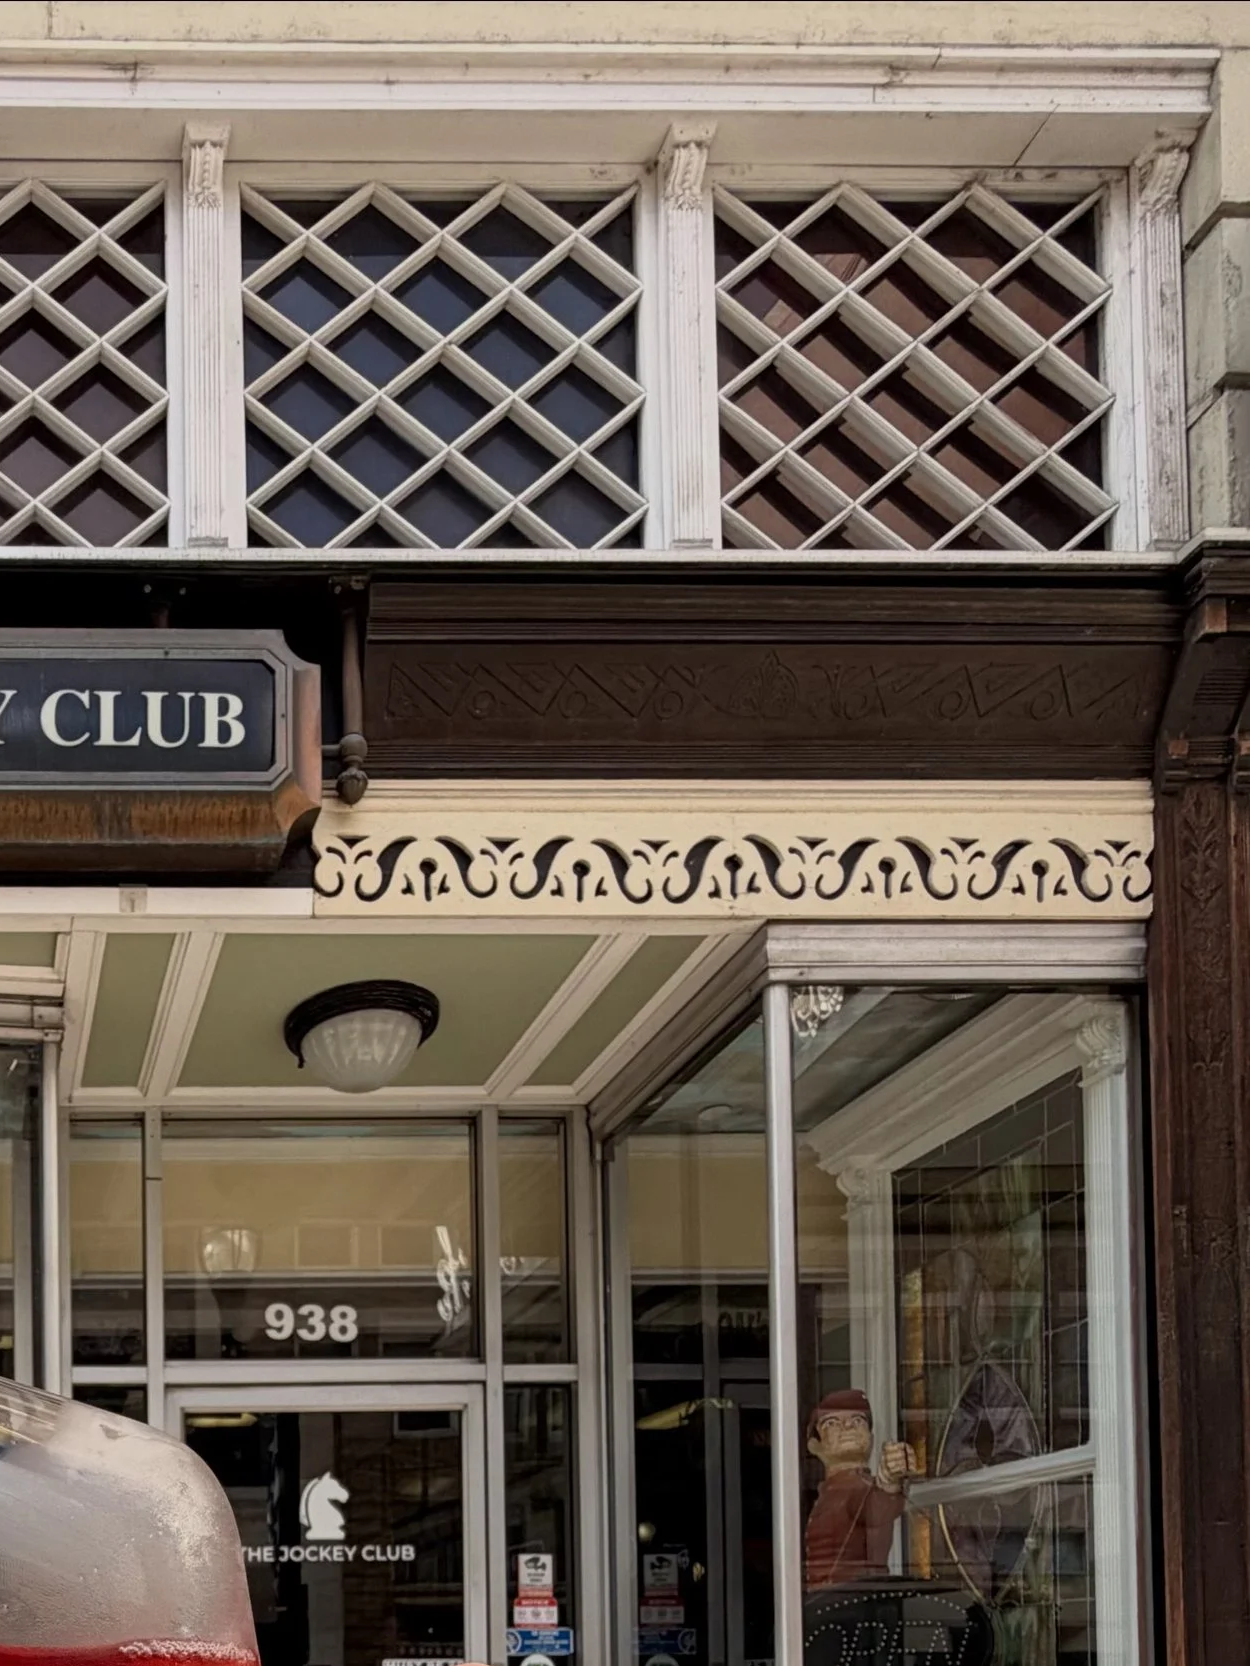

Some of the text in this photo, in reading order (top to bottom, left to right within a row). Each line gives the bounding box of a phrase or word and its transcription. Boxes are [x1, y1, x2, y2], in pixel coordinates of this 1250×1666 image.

[40, 689, 246, 748] CLUB
[264, 1302, 359, 1342] 938
[242, 1544, 416, 1563] THE JOCKEY CLUB
